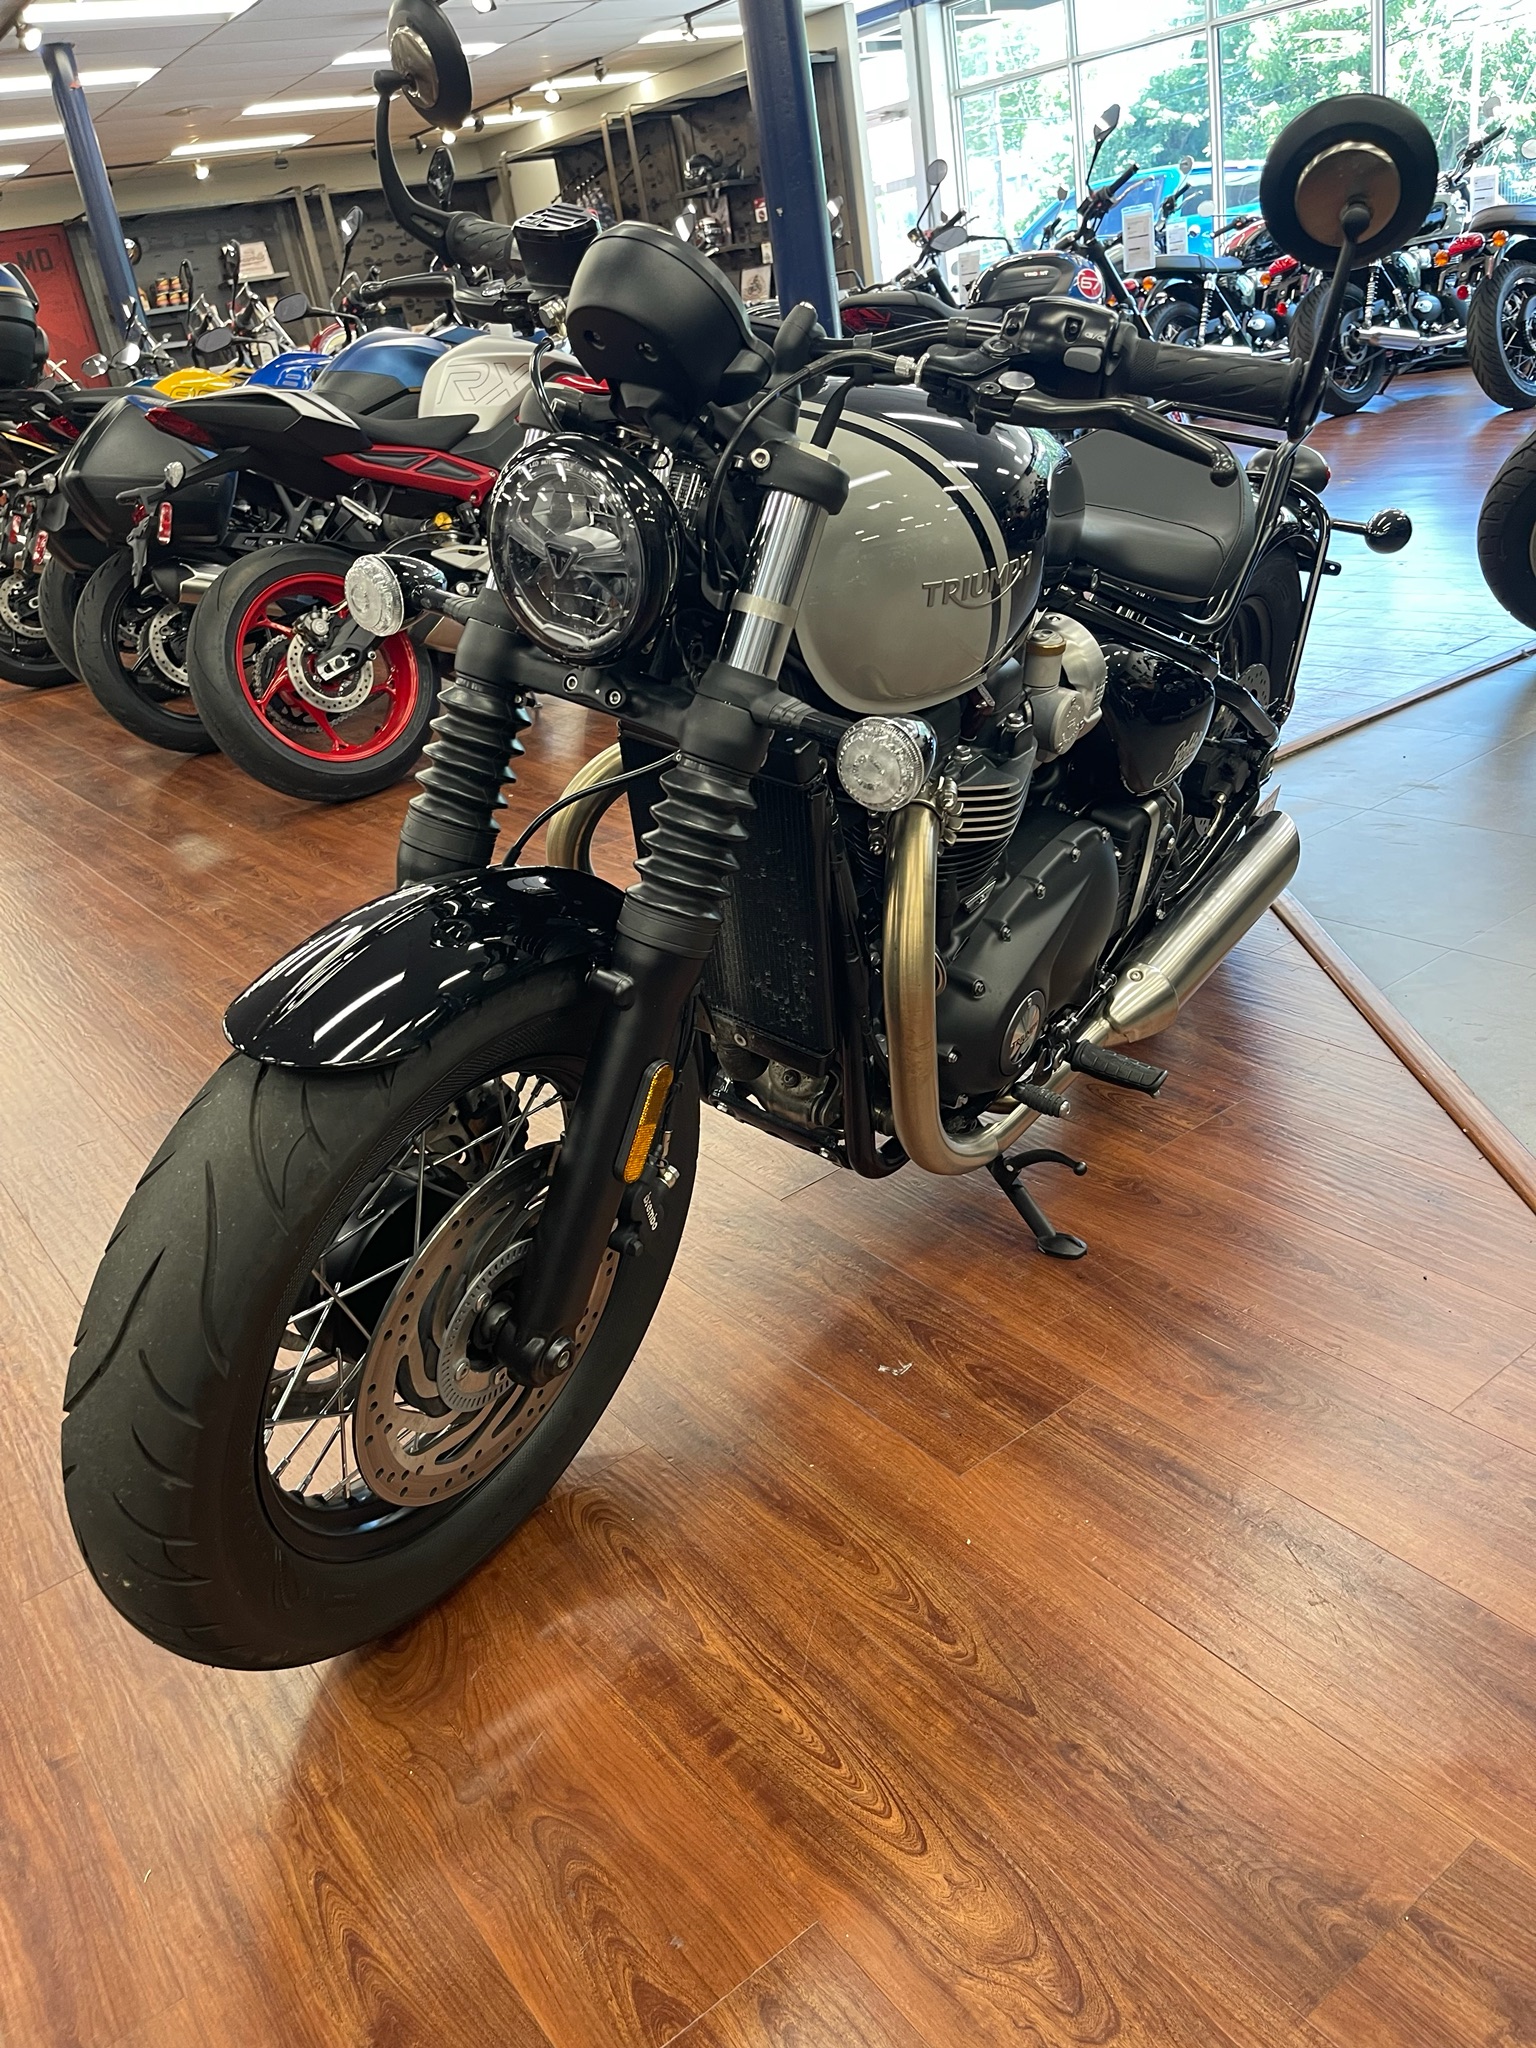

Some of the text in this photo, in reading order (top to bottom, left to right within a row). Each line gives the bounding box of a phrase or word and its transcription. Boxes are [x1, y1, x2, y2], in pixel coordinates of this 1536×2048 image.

[1079, 272, 1101, 291] 67
[437, 362, 530, 405] RX
[922, 550, 1033, 608] TRIUMPH
